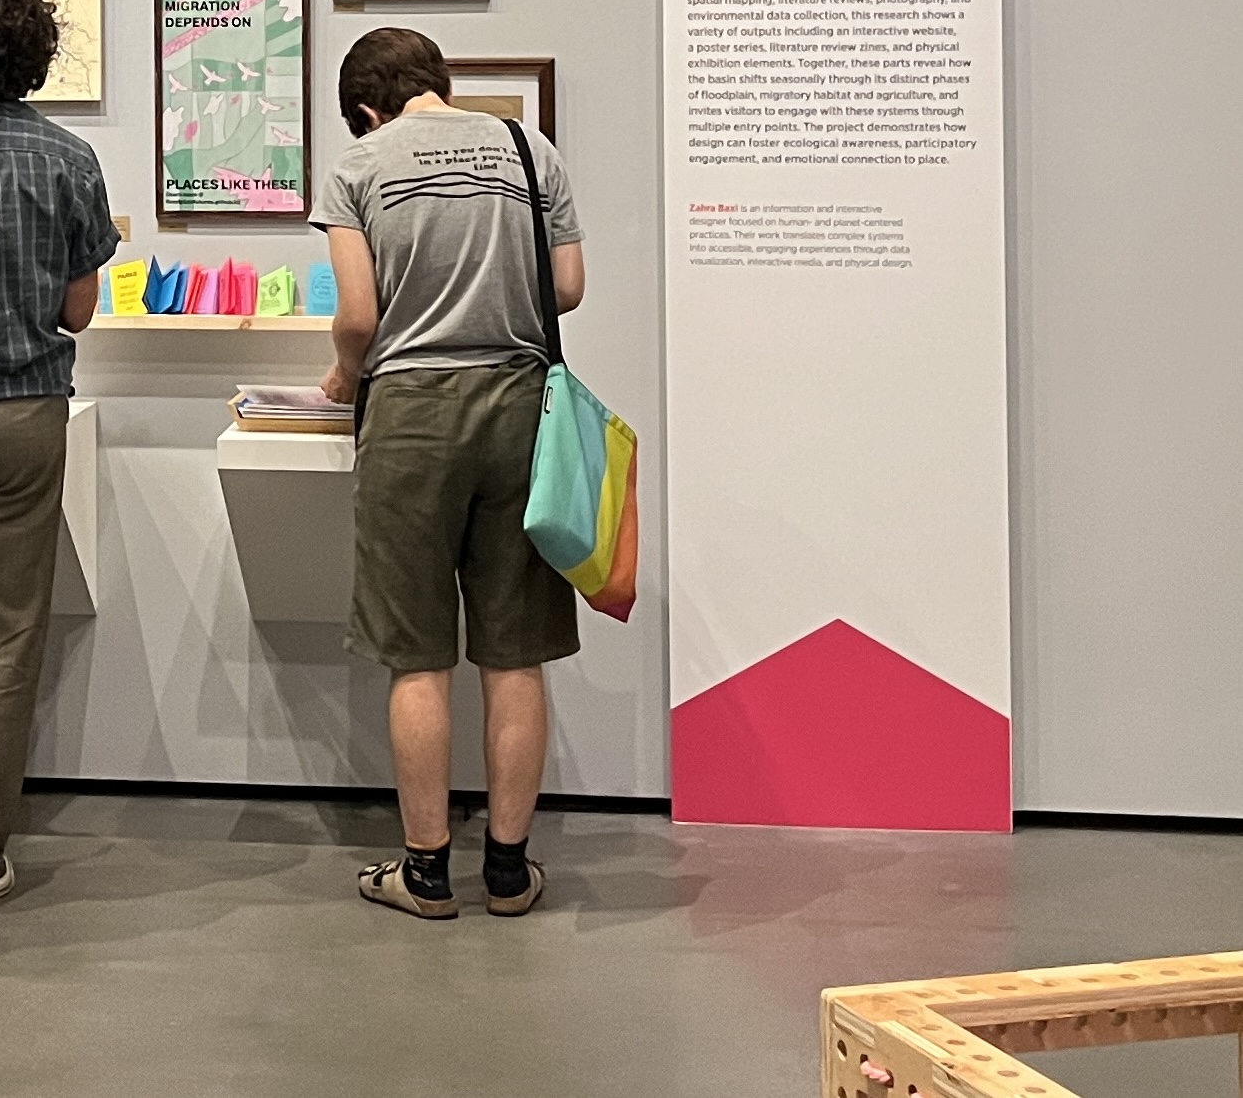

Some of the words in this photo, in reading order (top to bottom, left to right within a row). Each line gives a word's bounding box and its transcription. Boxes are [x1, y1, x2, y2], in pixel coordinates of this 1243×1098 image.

[165, 1, 240, 12] MIGRATION
[687, 10, 764, 20] environmental
[767, 10, 791, 20] data
[851, 10, 871, 20] this
[873, 10, 920, 20] research
[922, 9, 956, 20] shows
[958, 12, 965, 20] a
[165, 17, 229, 28] DEPENDS
[231, 17, 251, 28] ON
[688, 122, 731, 134] multiple
[734, 122, 761, 134] entry
[804, 122, 823, 132] The
[826, 122, 864, 134] project
[867, 122, 941, 132] demonstrates
[943, 122, 967, 132] how
[689, 138, 724, 150] design
[749, 138, 780, 148] foster
[783, 138, 839, 150] ecological
[905, 138, 978, 150] participatory
[445, 156, 477, 164] place
[762, 154, 782, 164] and
[785, 154, 839, 164] emotional
[841, 154, 902, 164] connection
[904, 154, 915, 164] to
[167, 179, 218, 189] PLACES
[222, 179, 250, 189] LIKE
[254, 180, 297, 190] THESE
